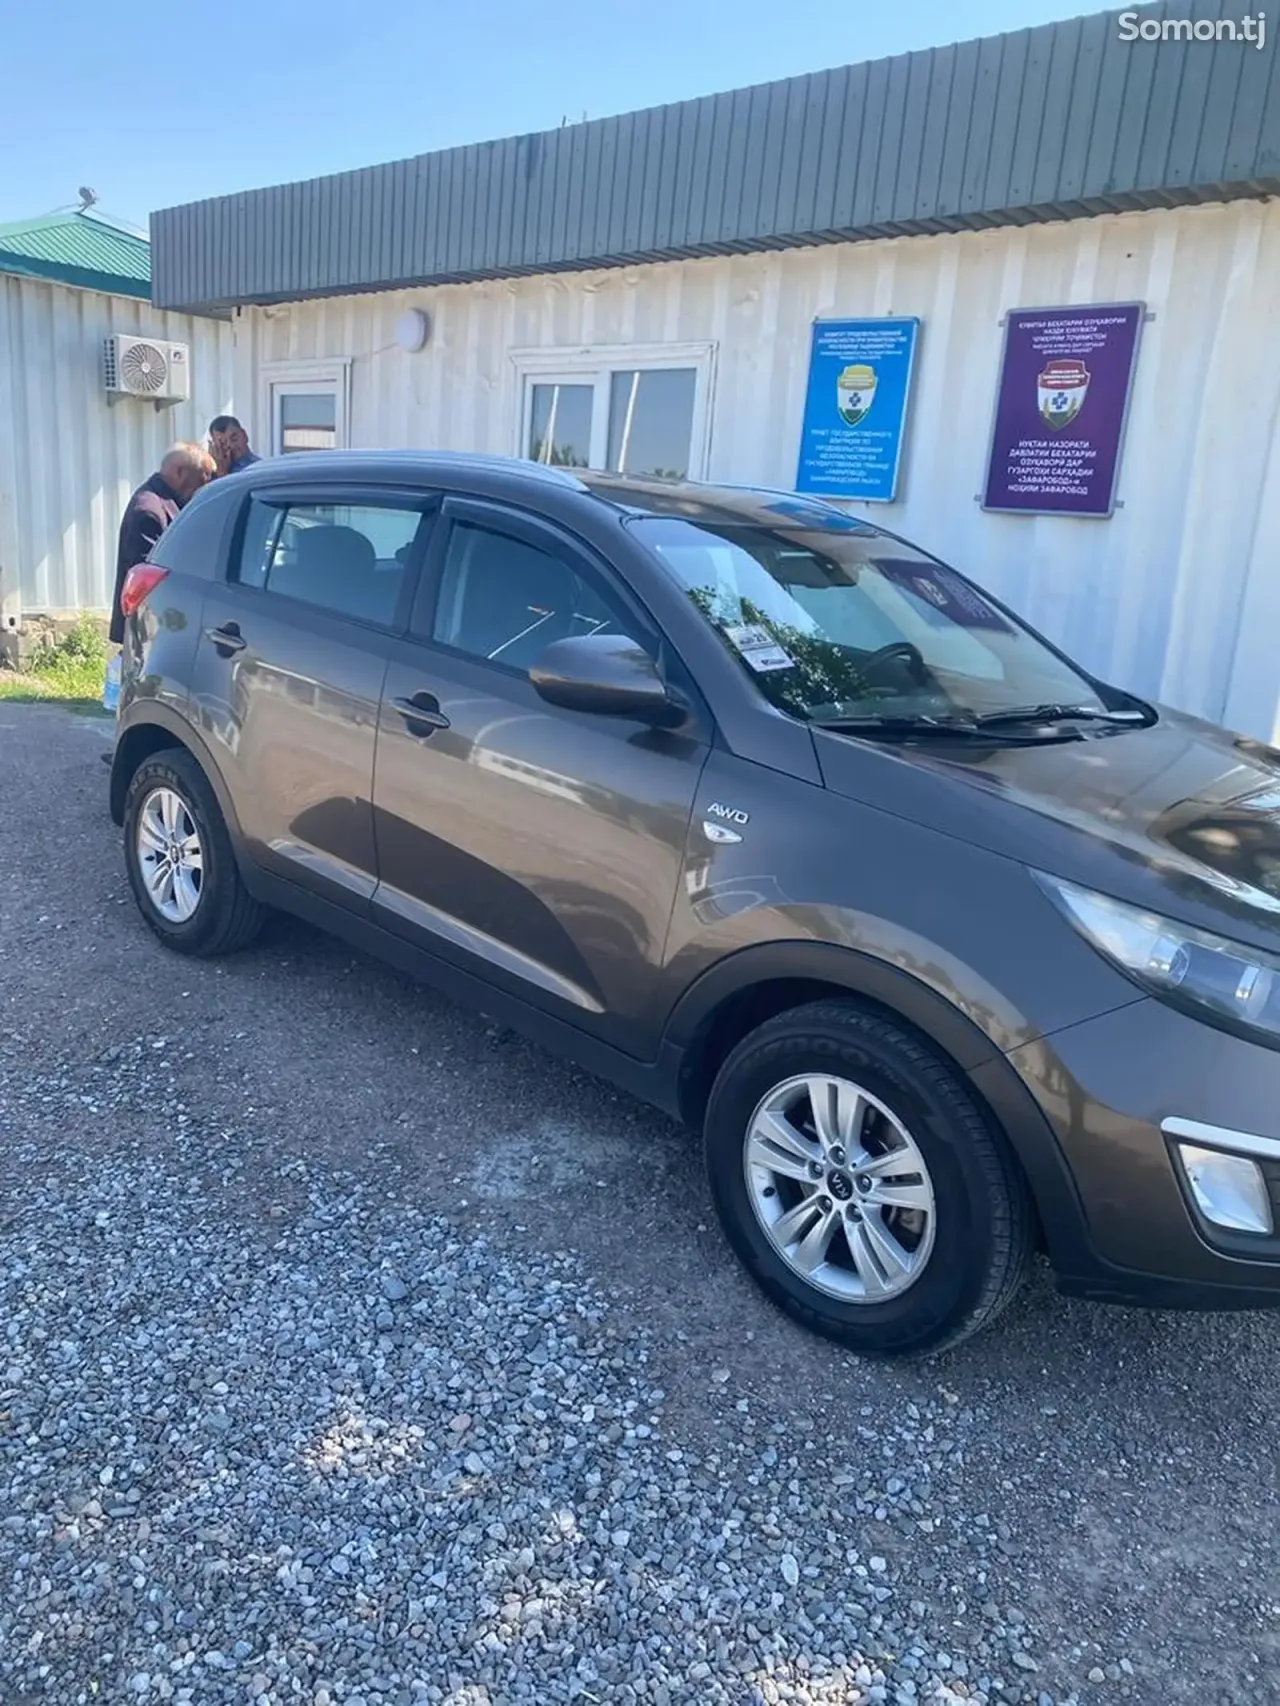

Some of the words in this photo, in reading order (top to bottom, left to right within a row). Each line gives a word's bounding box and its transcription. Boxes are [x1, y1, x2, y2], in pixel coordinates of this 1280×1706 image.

[1049, 440, 1090, 449] НАЗОРАТИ
[1066, 458, 1084, 467] ДАР
[707, 802, 749, 824] AWD
